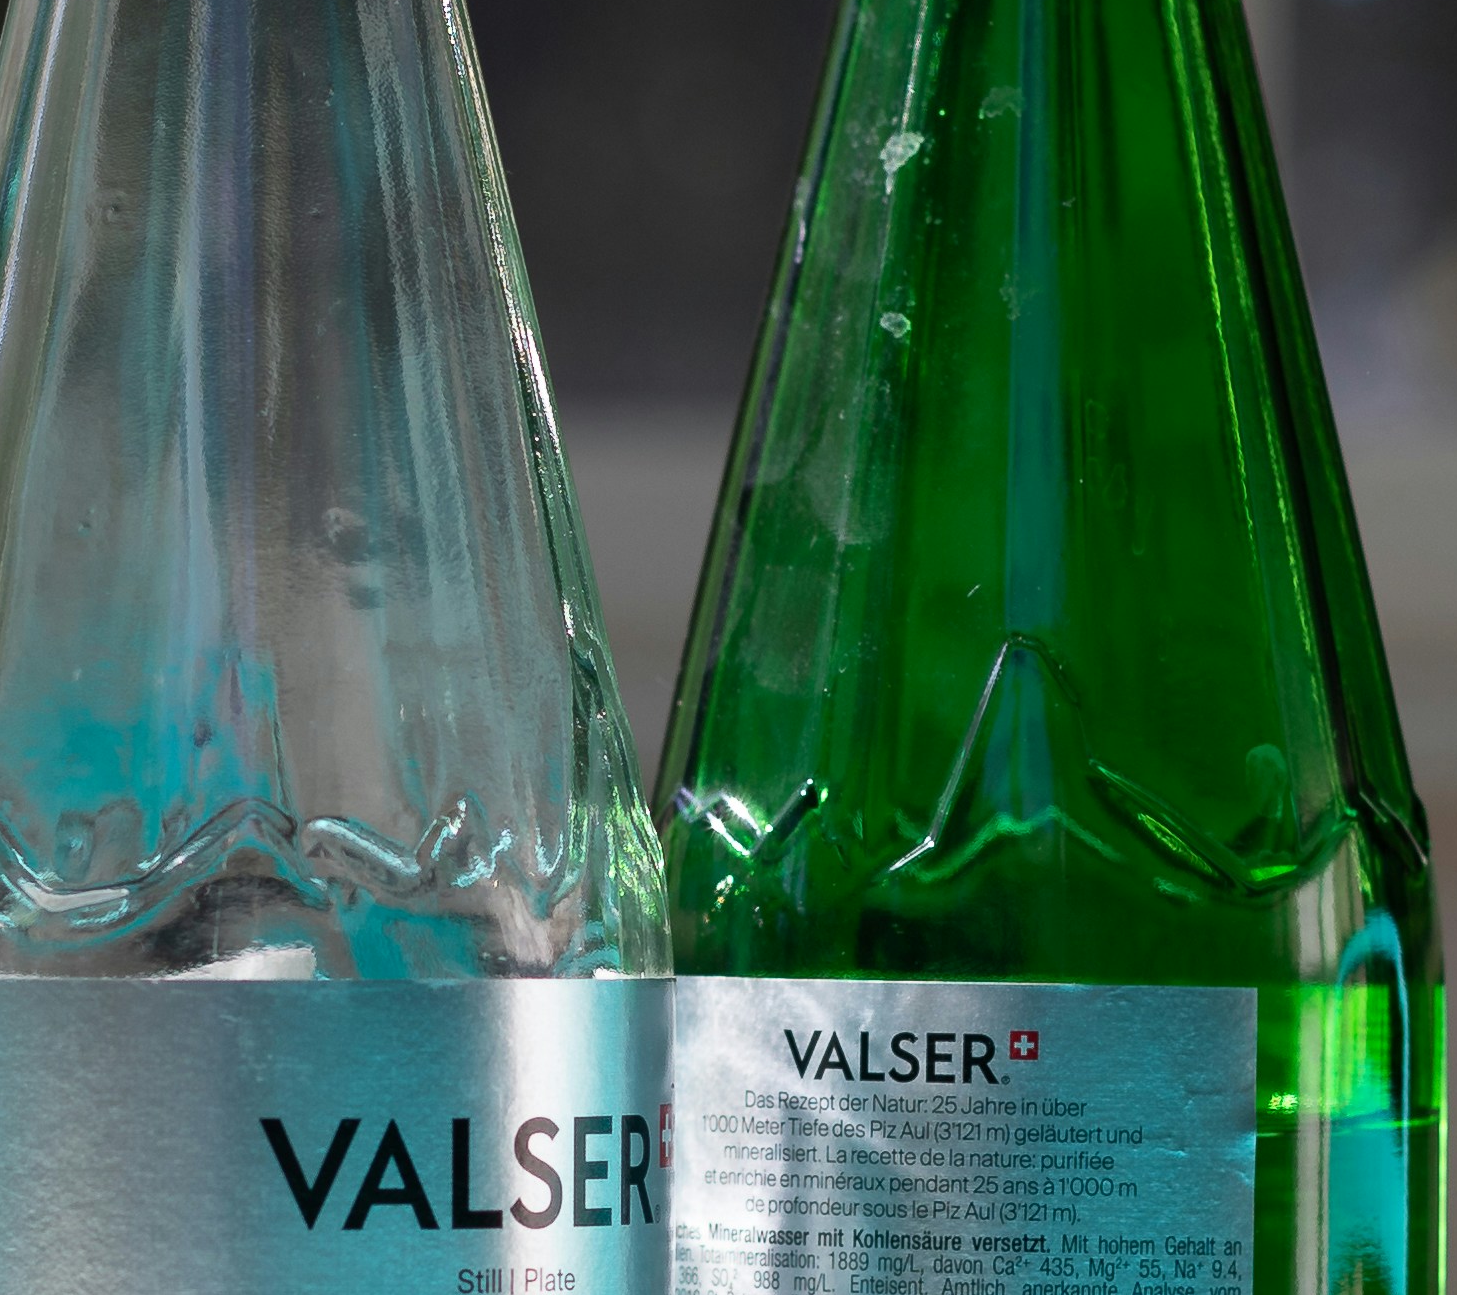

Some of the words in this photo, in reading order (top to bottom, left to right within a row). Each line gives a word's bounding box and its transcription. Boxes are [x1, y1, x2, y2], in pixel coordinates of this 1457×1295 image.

[745, 1090, 774, 1109] Das
[778, 1091, 835, 1116] Rezept
[839, 1093, 868, 1112] der
[872, 1093, 928, 1113] Natur:
[932, 1095, 957, 1114] 25
[960, 1096, 1016, 1115] Jahre
[1021, 1097, 1037, 1116] in
[1042, 1097, 1087, 1117] über
[742, 1115, 785, 1135] Meter
[789, 1117, 828, 1137] Tiefe
[832, 1118, 865, 1138] des
[870, 1119, 896, 1139] Piz
[901, 1120, 929, 1140] Aul
[934, 1121, 981, 1145] (3'121
[987, 1123, 1009, 1147] m)
[1014, 1123, 1102, 1147] geläutert
[1107, 1125, 1143, 1144] und
[724, 1141, 821, 1163] mineralisiert.
[826, 1145, 847, 1164] La
[851, 1147, 916, 1166] recette
[920, 1147, 944, 1166] de
[949, 1148, 965, 1167] la
[969, 1149, 1036, 1169] nature:
[1041, 1151, 1114, 1174] purifiée
[705, 1165, 716, 1184] et
[720, 1166, 776, 1187] enrichie
[780, 1173, 800, 1188] en
[804, 1170, 885, 1191] minéraux
[889, 1173, 969, 1196] pendant
[973, 1175, 998, 1194] 25
[1003, 1180, 1039, 1195] ans
[1043, 1177, 1055, 1195] à
[1059, 1177, 1114, 1197] 1'000
[1119, 1183, 1137, 1197] m
[746, 1193, 764, 1212] de
[769, 1195, 859, 1218] profondeur
[863, 1203, 907, 1218] sous
[913, 1200, 928, 1219] le
[933, 1200, 960, 1220] Piz
[966, 1201, 994, 1221] Aul
[1000, 1202, 1047, 1226] (3'121
[1053, 1203, 1081, 1227] m).
[709, 1221, 809, 1246] Mineralwasser
[818, 1228, 843, 1247] mit
[853, 1229, 961, 1251] Kohlensäure
[972, 1234, 1050, 1253] versetzt.
[1062, 1235, 1088, 1254] Mit
[1099, 1235, 1154, 1255] hohem
[1165, 1236, 1215, 1255] Gehalt
[1224, 1241, 1241, 1256] an
[458, 1268, 502, 1294] Still
[524, 1268, 575, 1292] Plate
[754, 1270, 780, 1290] 988
[794, 1272, 835, 1295] mg/L.
[851, 1274, 928, 1295] Enteisent.
[829, 1251, 869, 1271] 1889
[878, 1254, 924, 1277] mg/L,
[934, 1255, 983, 1275] davon
[1040, 1257, 1079, 1279] 435,
[1139, 1259, 1165, 1281] 55,
[1212, 1260, 1241, 1282] 9.4,
